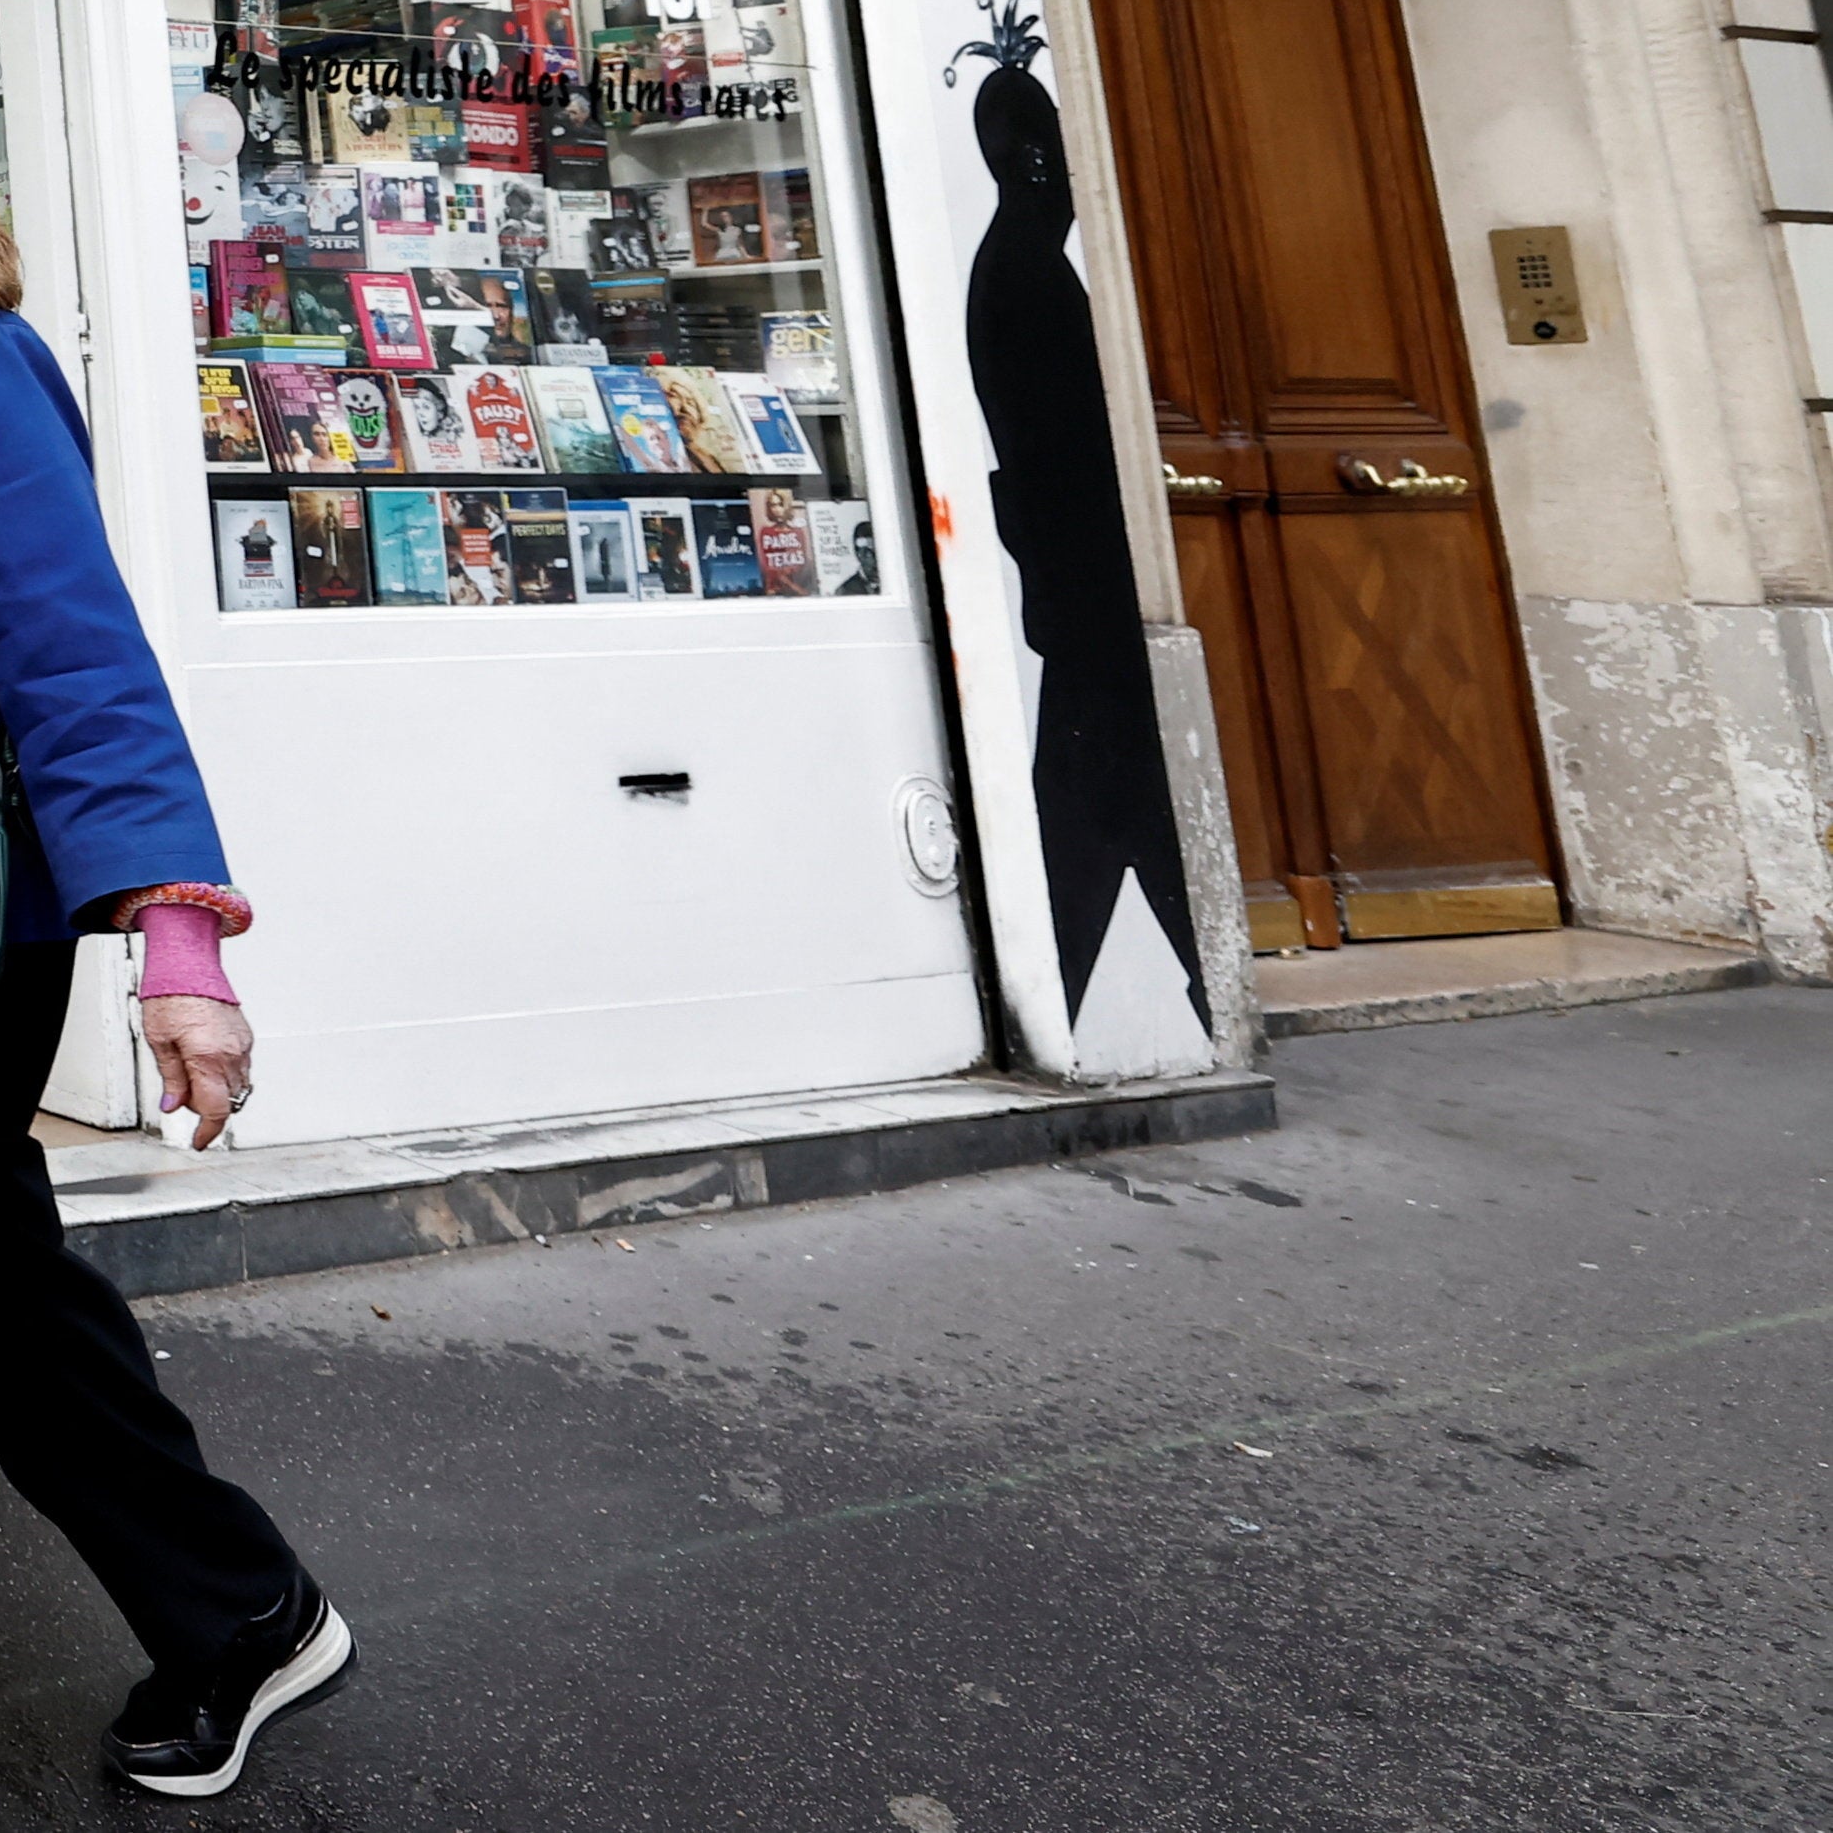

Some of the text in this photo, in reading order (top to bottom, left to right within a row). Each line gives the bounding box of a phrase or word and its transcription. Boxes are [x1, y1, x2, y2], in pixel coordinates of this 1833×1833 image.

[206, 29, 261, 90] Le
[511, 54, 571, 107] des
[588, 55, 683, 124] films
[476, 403, 524, 423] FAUST
